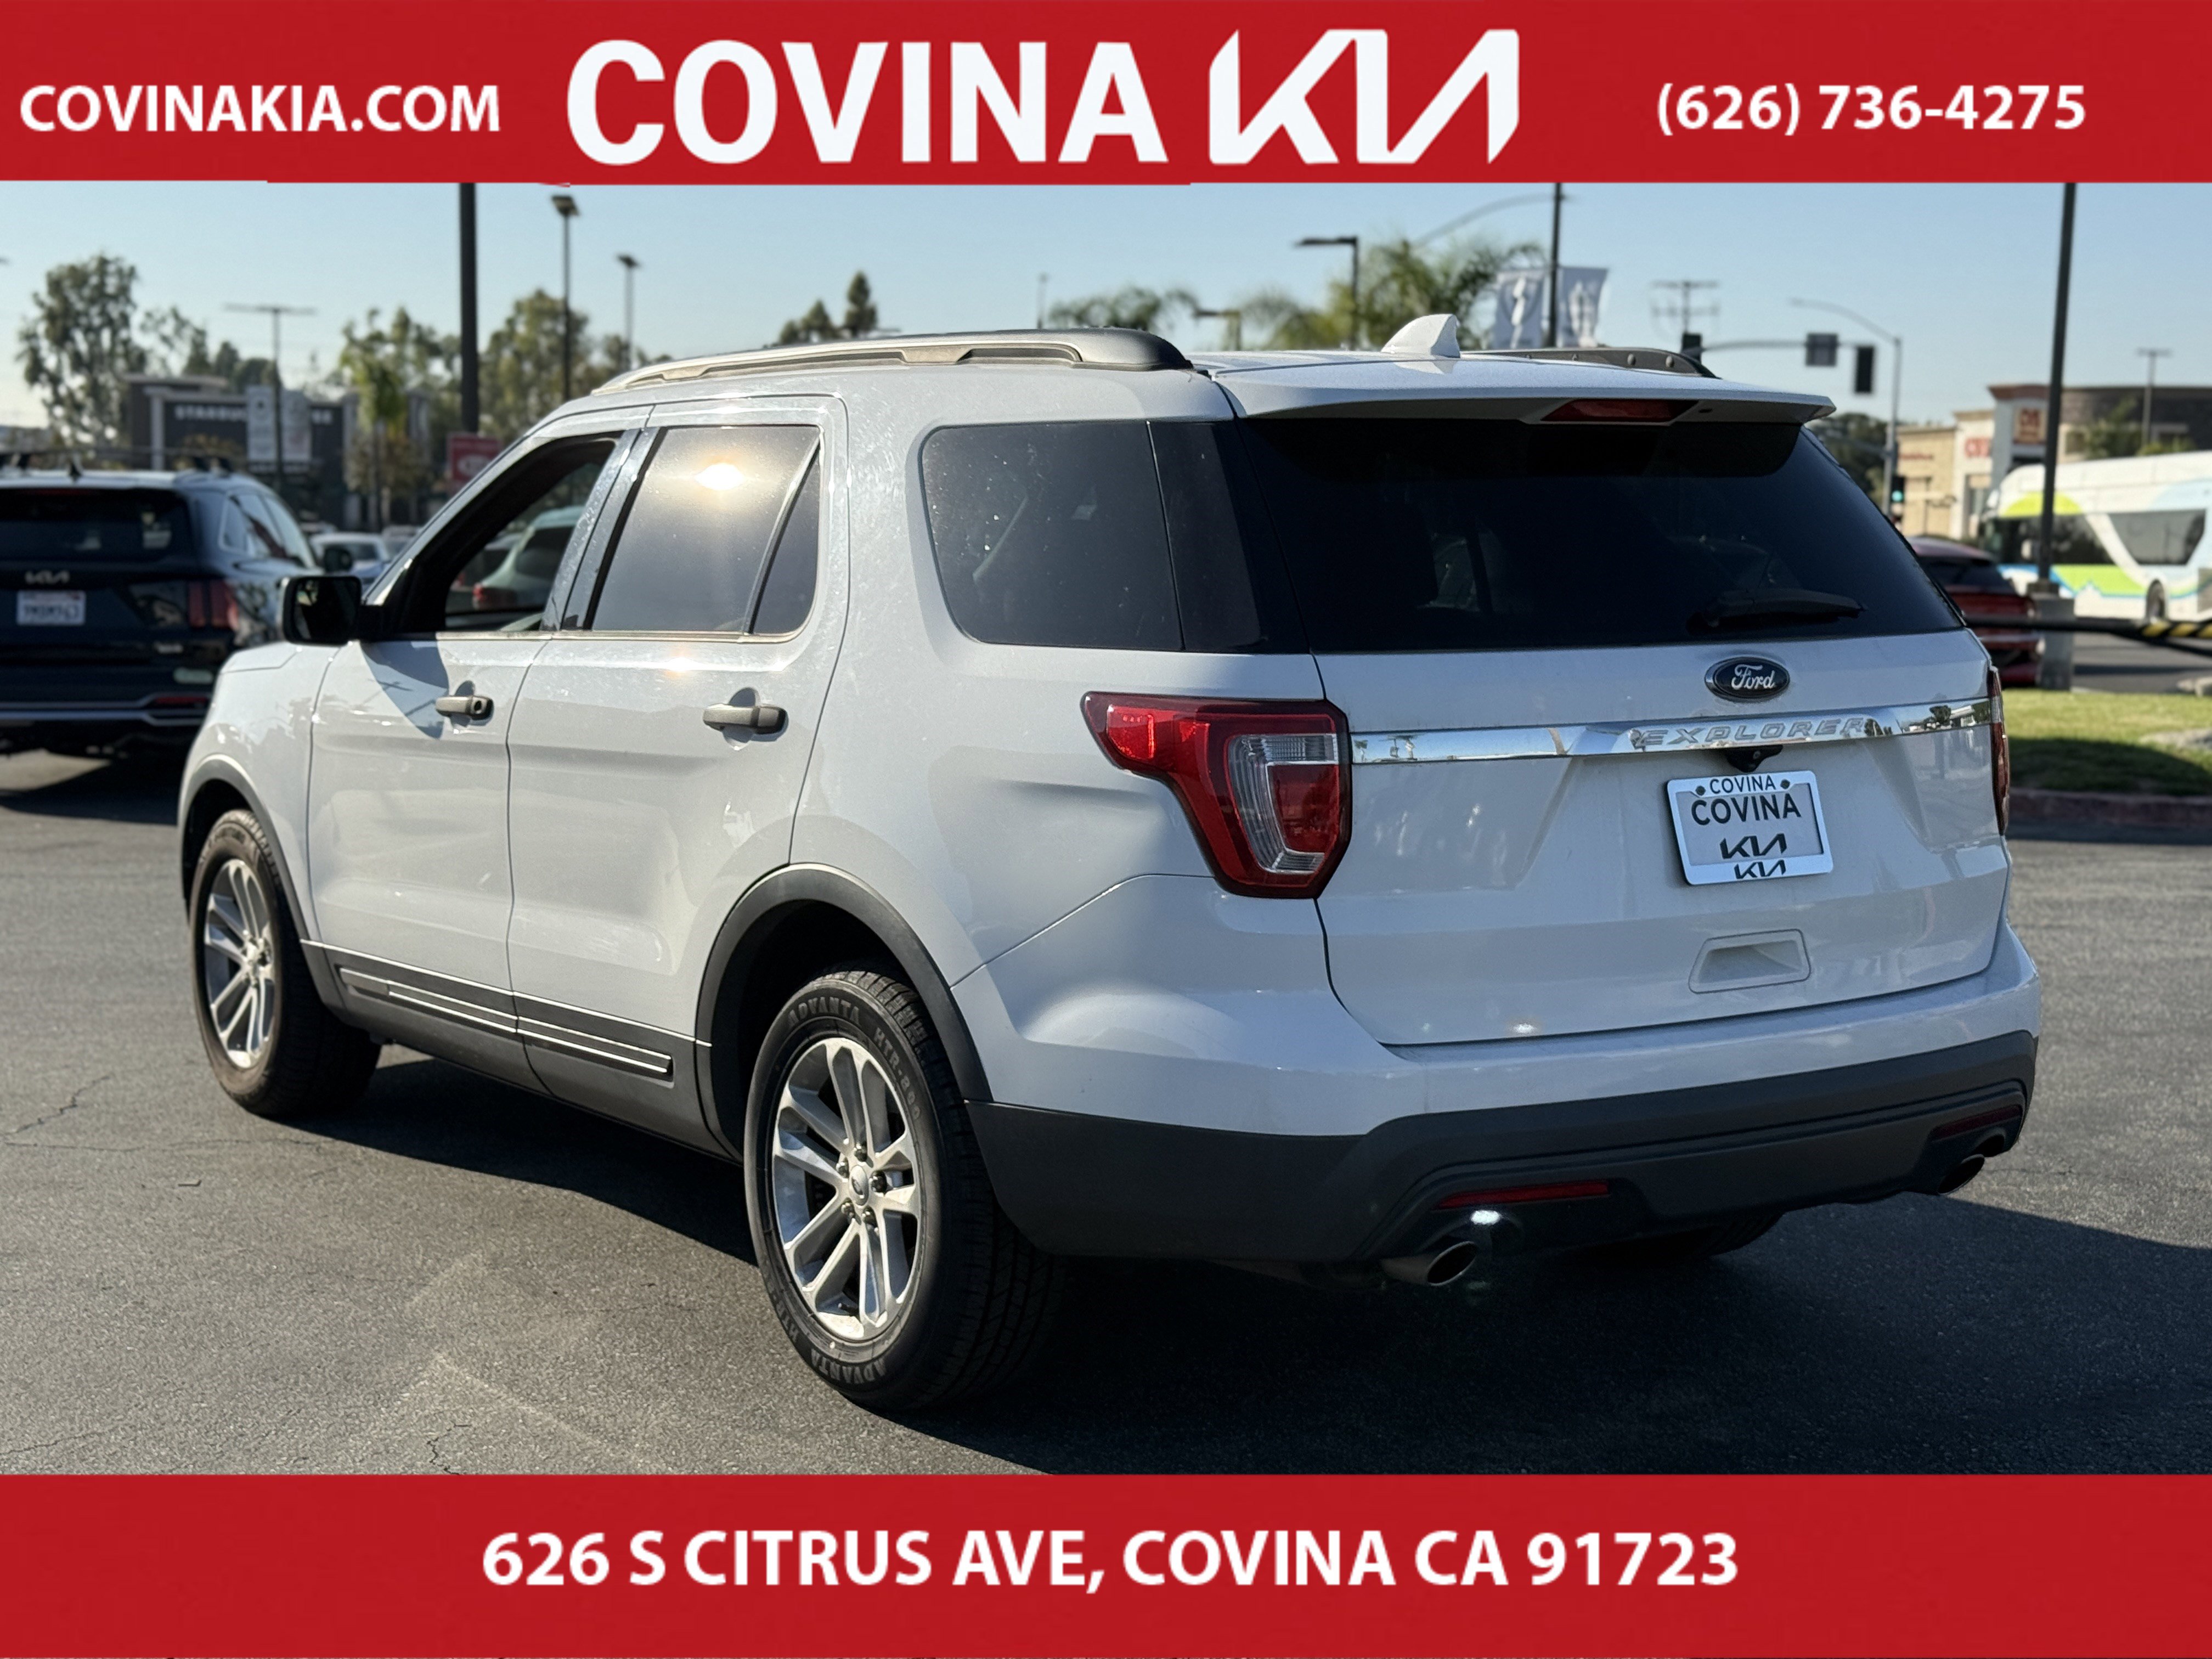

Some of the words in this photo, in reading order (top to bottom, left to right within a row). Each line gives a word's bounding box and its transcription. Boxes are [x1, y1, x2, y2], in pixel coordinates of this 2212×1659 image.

[1731, 664, 1776, 691] Ford
[1635, 717, 1865, 748] EXPLORER
[1709, 775, 1777, 794] COVINA
[1691, 793, 1802, 826] COVINA
[1719, 833, 1787, 860] KIA
[1734, 859, 1786, 879] KIA
[788, 996, 860, 1028] ADVANTA
[874, 1026, 921, 1120] HTR-800
[810, 1347, 888, 1385] ADVANTA
